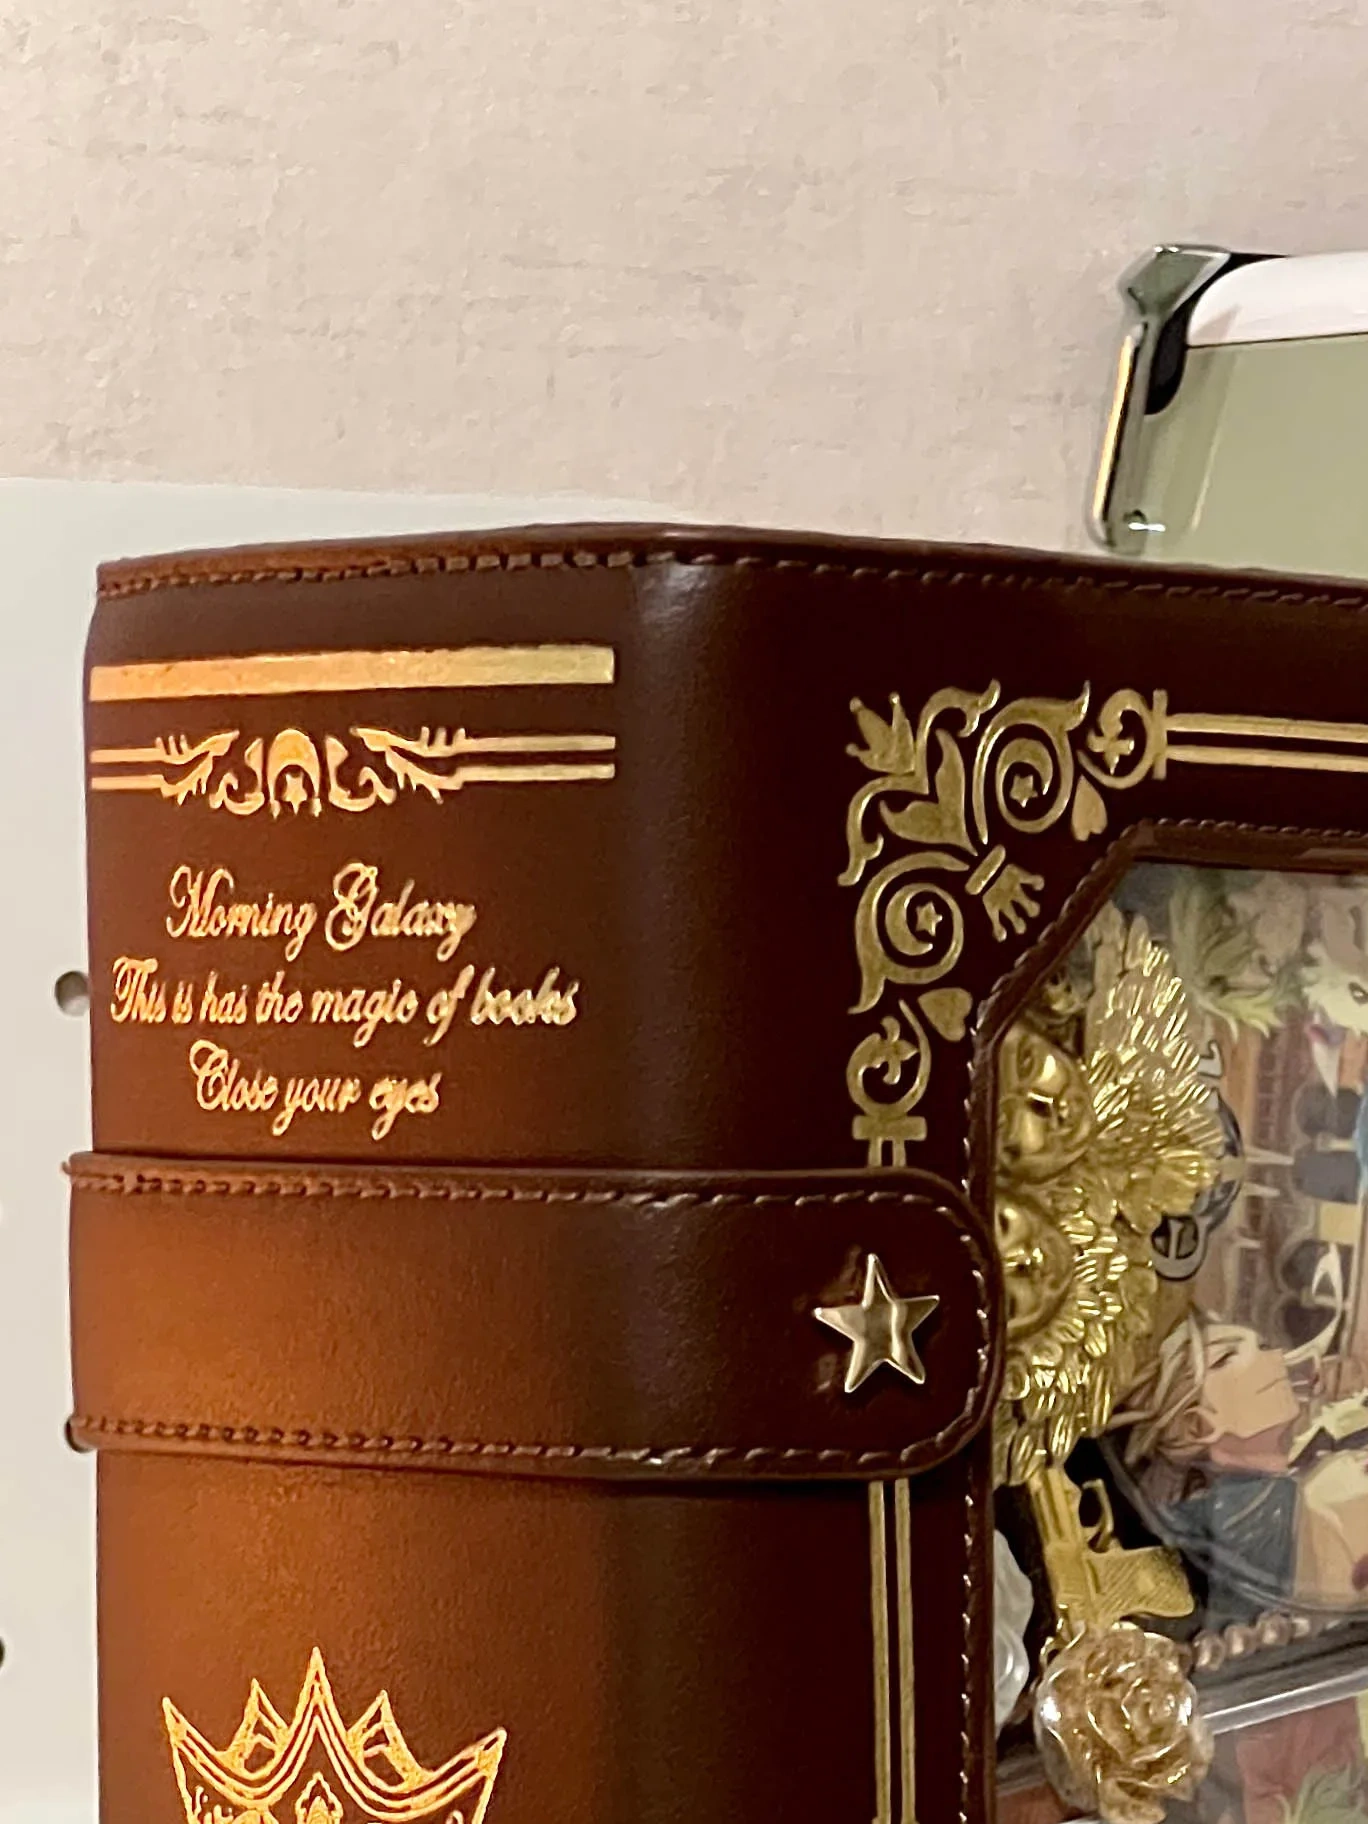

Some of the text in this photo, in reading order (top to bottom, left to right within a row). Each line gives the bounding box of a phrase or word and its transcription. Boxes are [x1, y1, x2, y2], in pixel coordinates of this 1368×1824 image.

[166, 862, 476, 962] Morning Galaxy
[111, 956, 579, 1048] This is has the magic of books
[189, 1040, 442, 1140] Close your eyes
